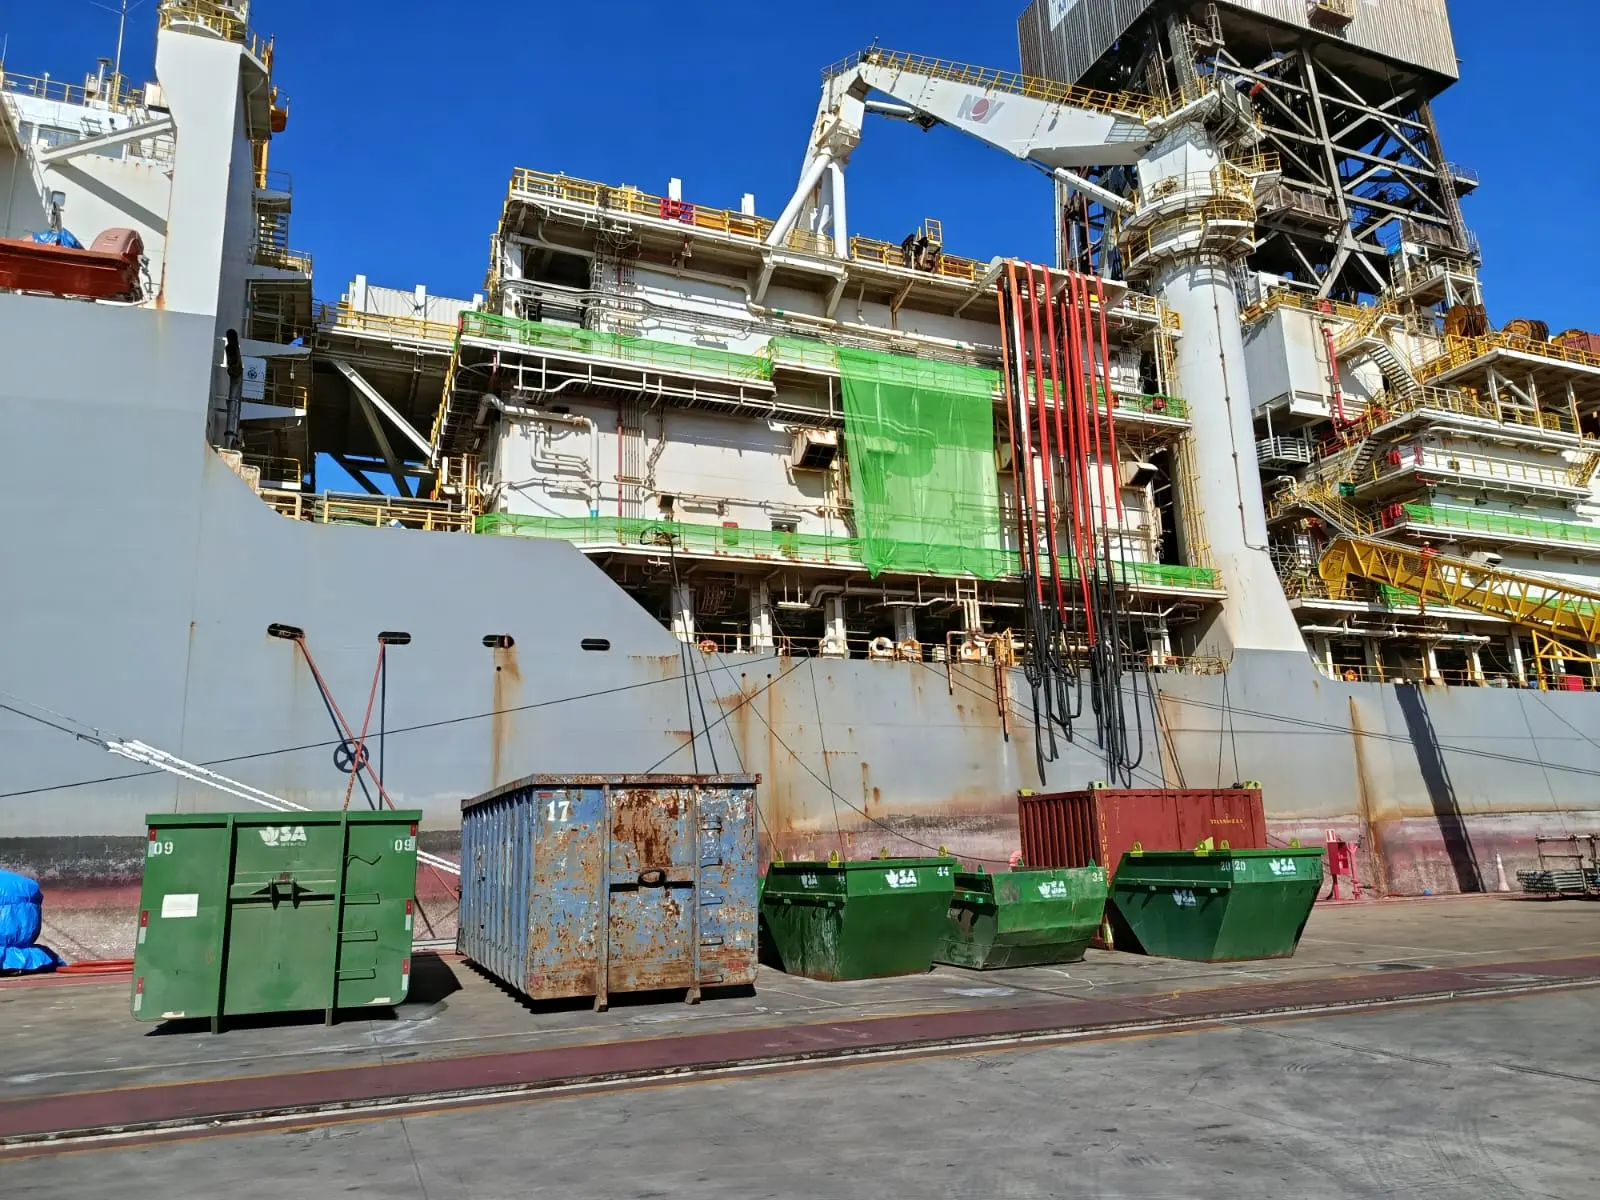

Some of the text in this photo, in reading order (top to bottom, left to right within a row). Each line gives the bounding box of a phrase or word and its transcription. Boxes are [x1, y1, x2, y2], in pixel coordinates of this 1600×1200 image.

[547, 800, 570, 821] 17
[154, 841, 174, 855] 09
[1220, 861, 1231, 871] 20
[1234, 860, 1246, 871] 20
[936, 866, 949, 877] 44
[1092, 872, 1104, 882] 34
